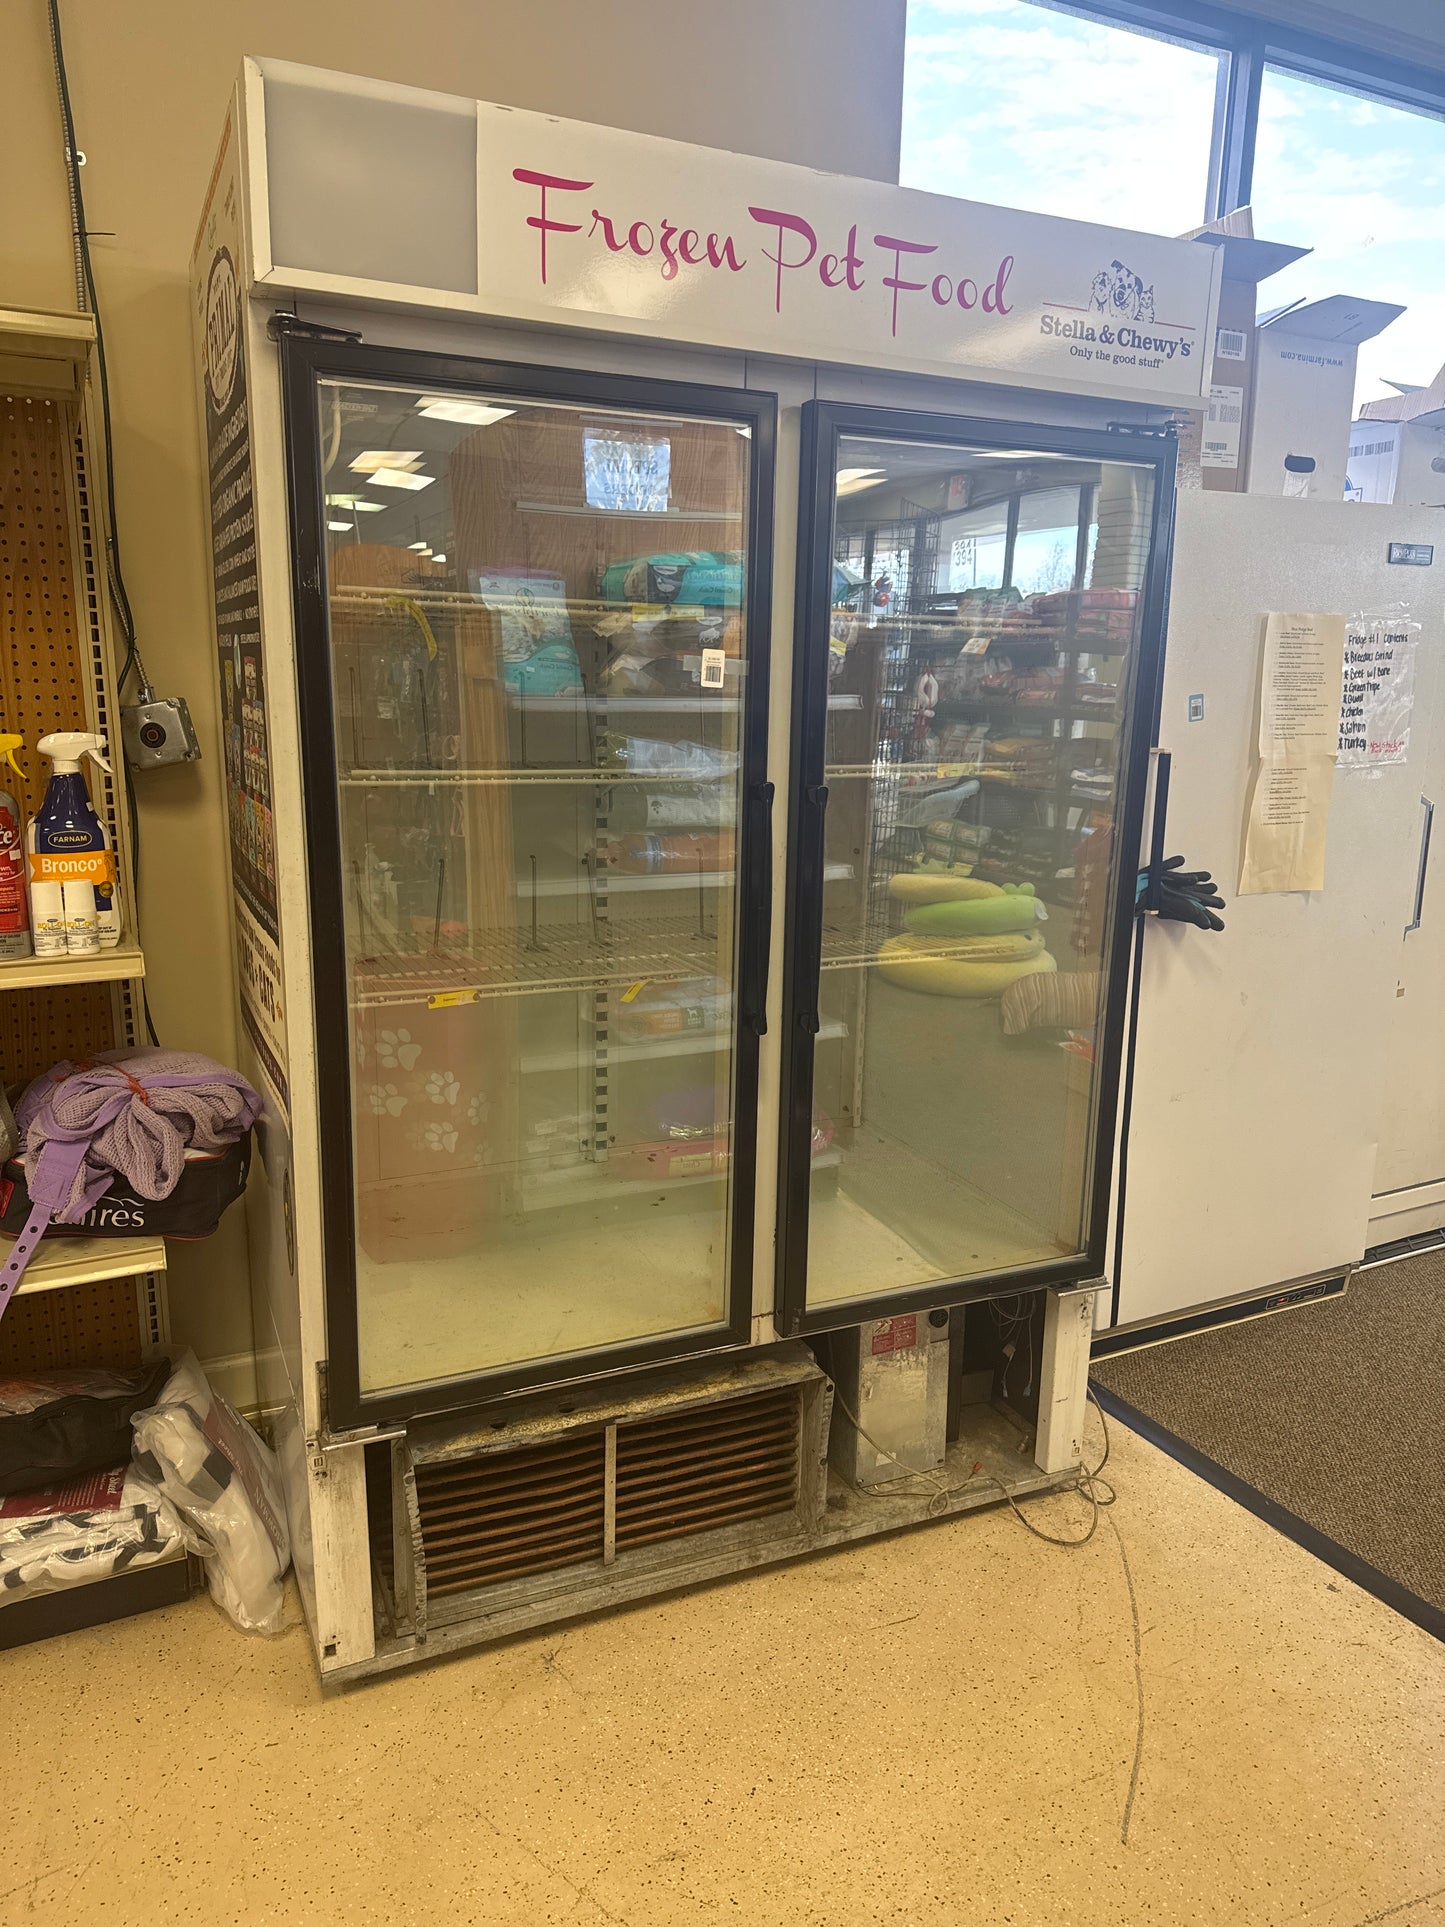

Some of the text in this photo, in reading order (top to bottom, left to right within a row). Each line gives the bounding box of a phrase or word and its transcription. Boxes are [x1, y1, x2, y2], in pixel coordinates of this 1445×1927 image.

[512, 167, 1015, 338] Frozen Pet Food
[1040, 314, 1192, 359] Stella & Chewy's
[1069, 346, 1161, 369] Only the good stuff
[1280, 351, 1344, 367] www.farmina.com
[1348, 634, 1367, 649] Fridge
[1383, 633, 1408, 644] Contents
[1375, 649, 1393, 660] Grind
[1350, 668, 1364, 680] Beef
[1377, 667, 1391, 677] Bone
[1348, 682, 1366, 694] Green
[1347, 693, 1364, 704] Quail
[1345, 721, 1366, 735] Salmon
[1344, 737, 1367, 752] Turkey
[53, 835, 88, 843] FARNAM
[41, 858, 96, 873] Bronco
[259, 964, 276, 1023] CATS
